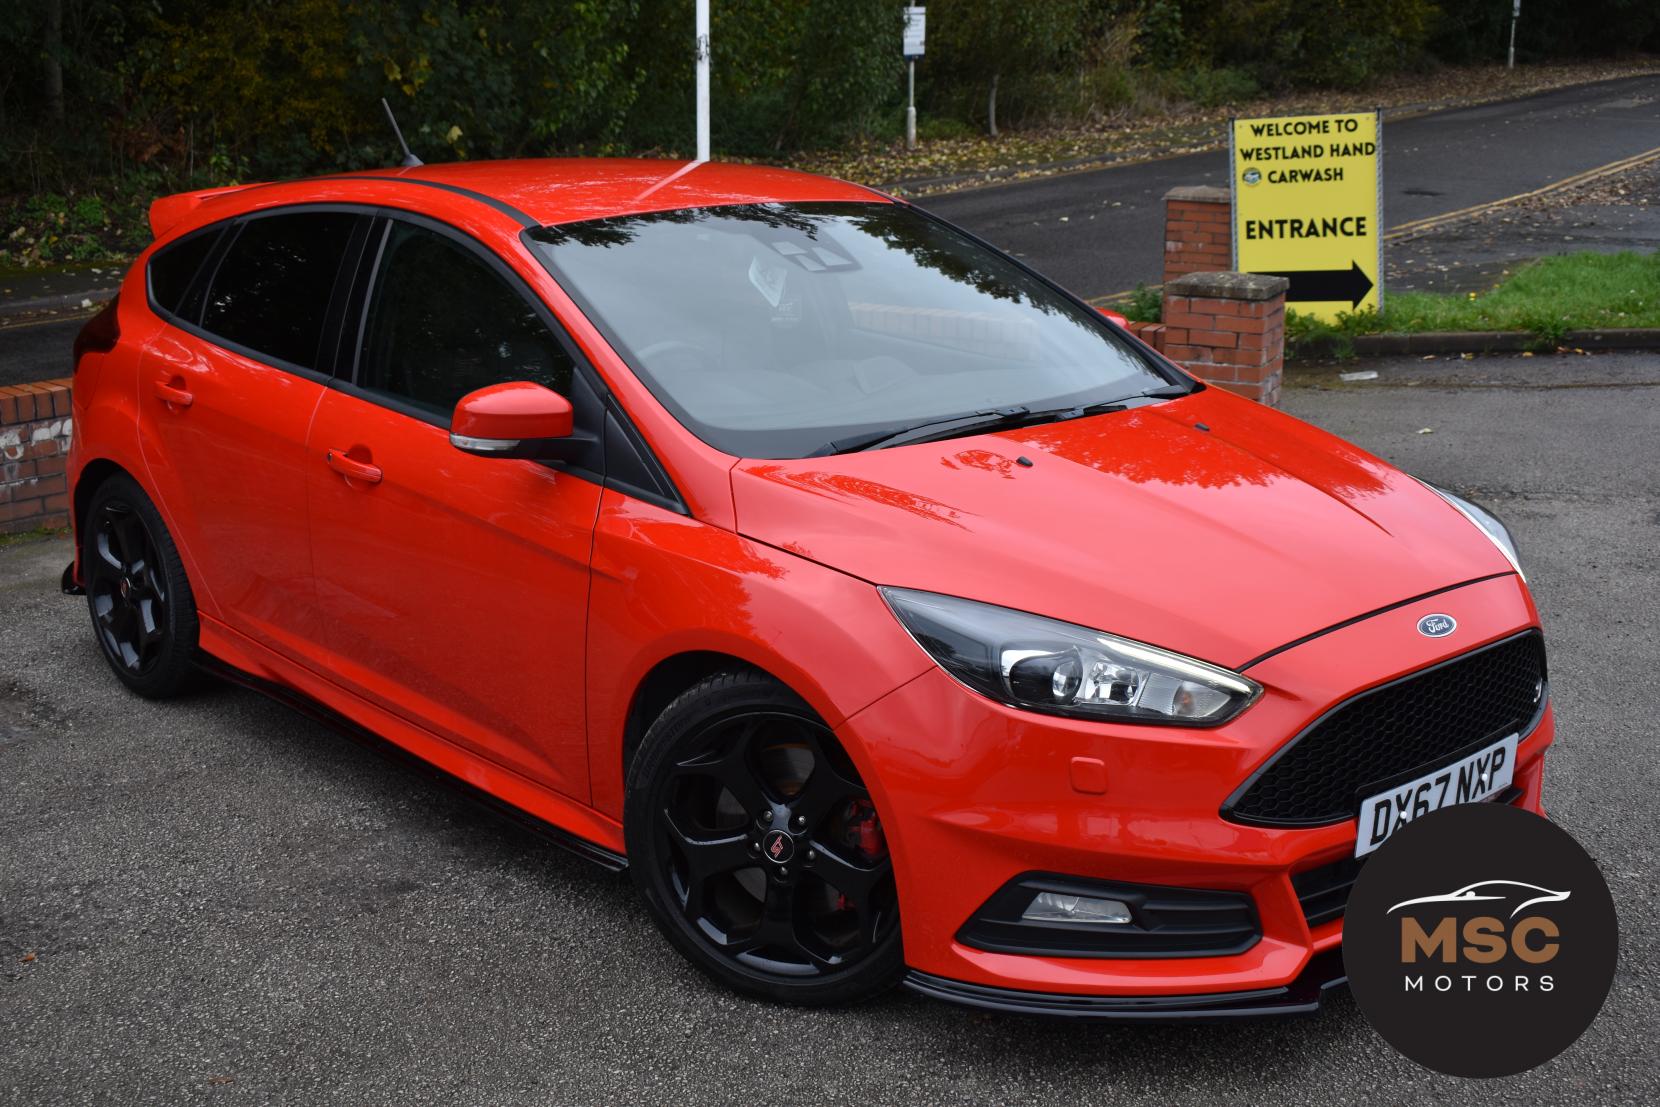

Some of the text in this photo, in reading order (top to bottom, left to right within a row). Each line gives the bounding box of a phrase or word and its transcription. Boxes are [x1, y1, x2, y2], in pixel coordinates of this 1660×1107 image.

[1250, 118, 1358, 137] WELCOME TO
[1239, 142, 1375, 161] WESTLAND HAND
[1267, 167, 1343, 183] CARWASH
[1246, 216, 1367, 240] ENTRANCE
[1425, 618, 1449, 633] Ford
[1370, 746, 1506, 846] DX67 NXP
